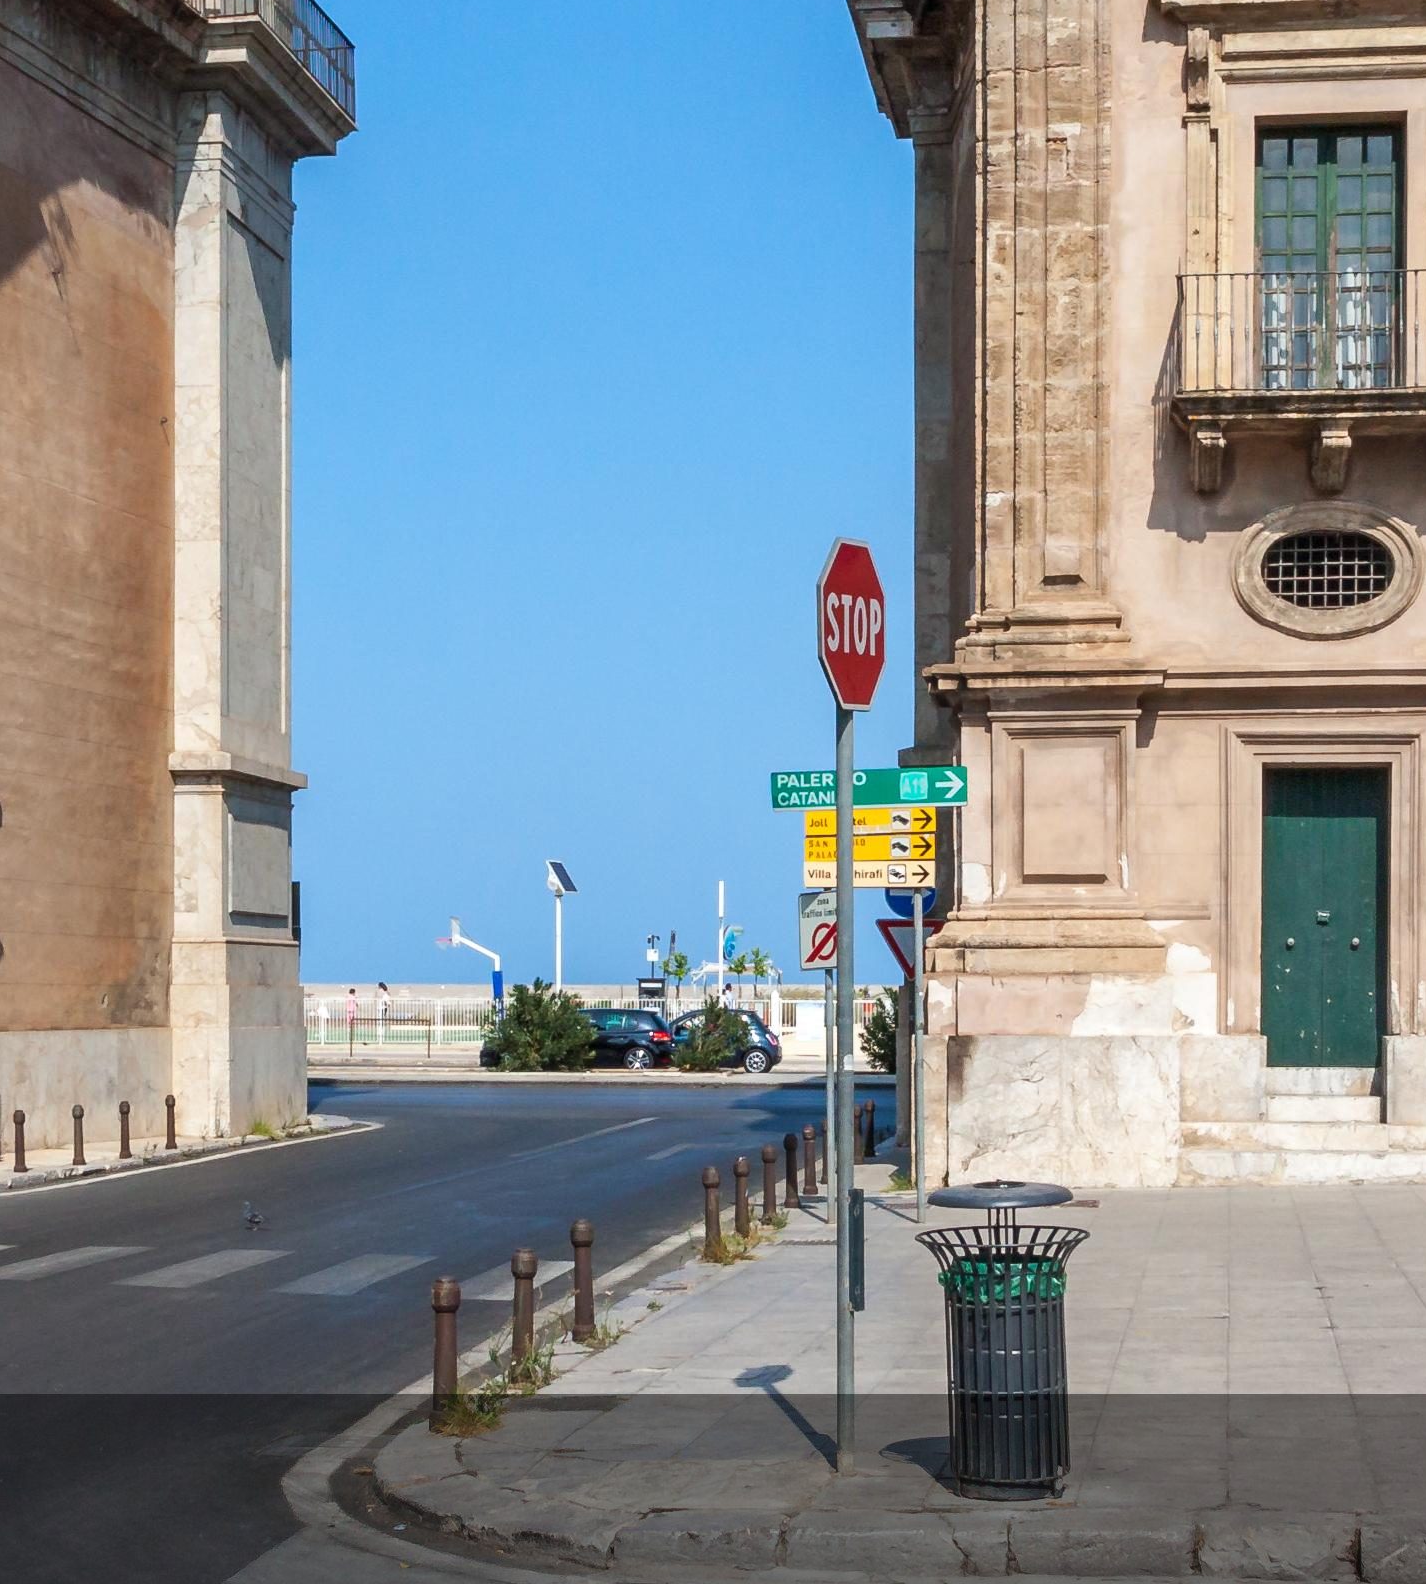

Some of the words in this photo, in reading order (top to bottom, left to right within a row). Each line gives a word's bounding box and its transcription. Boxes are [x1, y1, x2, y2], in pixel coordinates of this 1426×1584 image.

[827, 592, 882, 656] STOP
[777, 771, 866, 788] PALERO
[777, 790, 835, 806] CATANI
[809, 840, 828, 848] SAN
[807, 869, 831, 879] Villa
